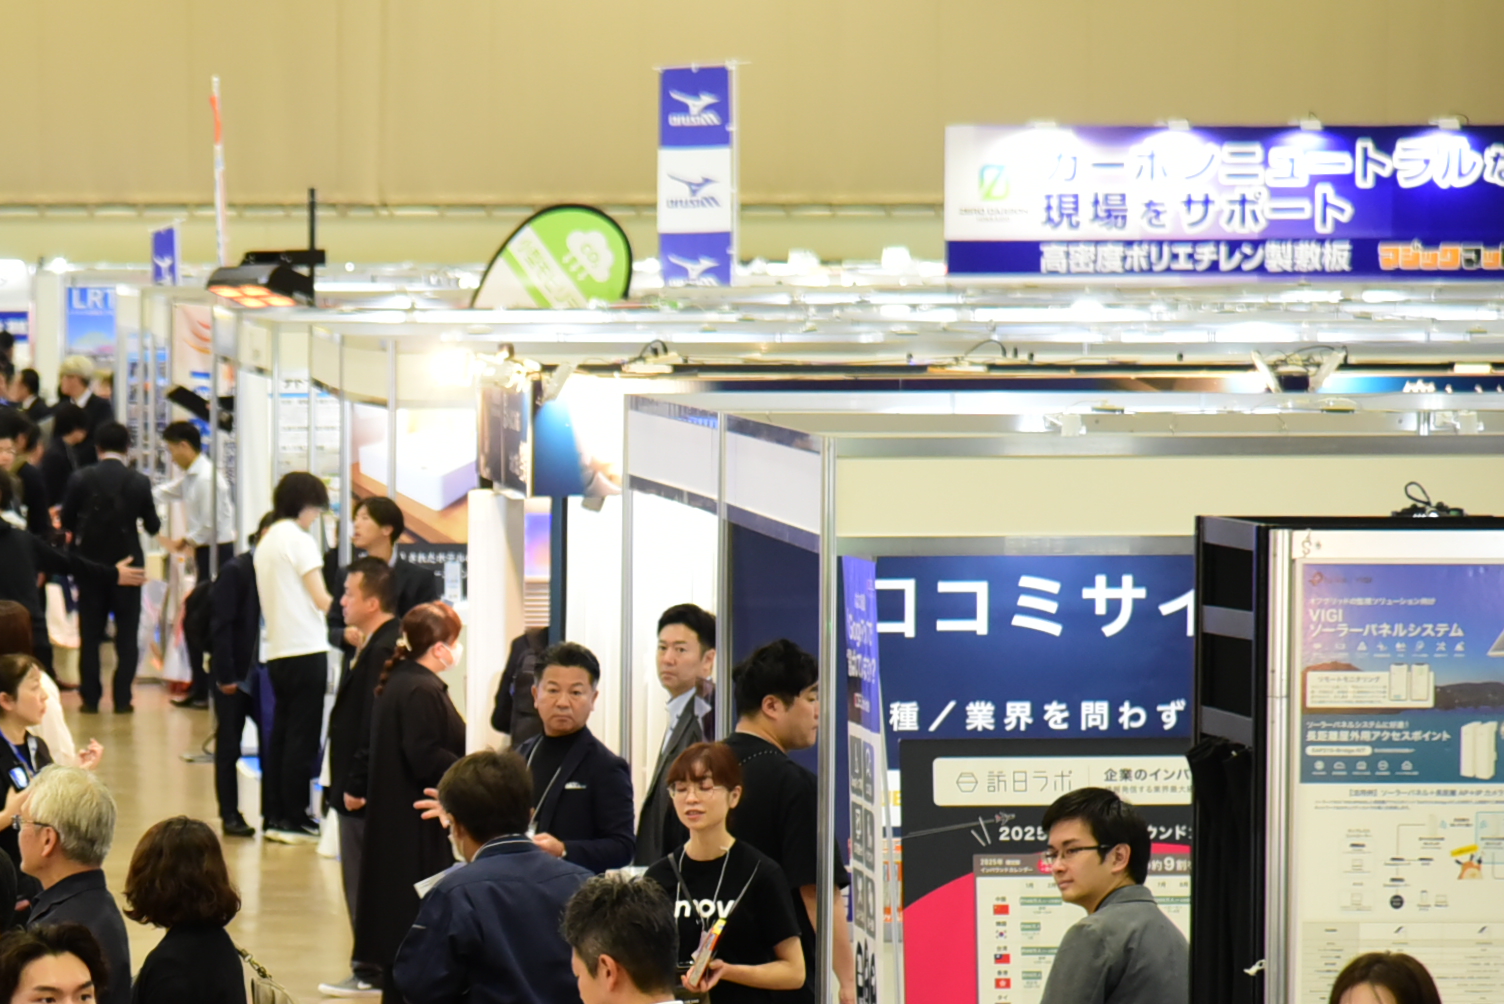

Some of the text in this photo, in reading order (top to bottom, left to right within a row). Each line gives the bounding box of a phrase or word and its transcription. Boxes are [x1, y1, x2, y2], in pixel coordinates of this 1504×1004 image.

[1041, 182, 1355, 235] 現場をサポート
[1039, 240, 1354, 274] 高密度ポリエチレン製敷板
[1309, 608, 1343, 622] VIGI
[1309, 623, 1465, 638] ソーラーパネルシステム
[986, 770, 1073, 793] 訪日ラボ
[999, 825, 1047, 841] 2025
